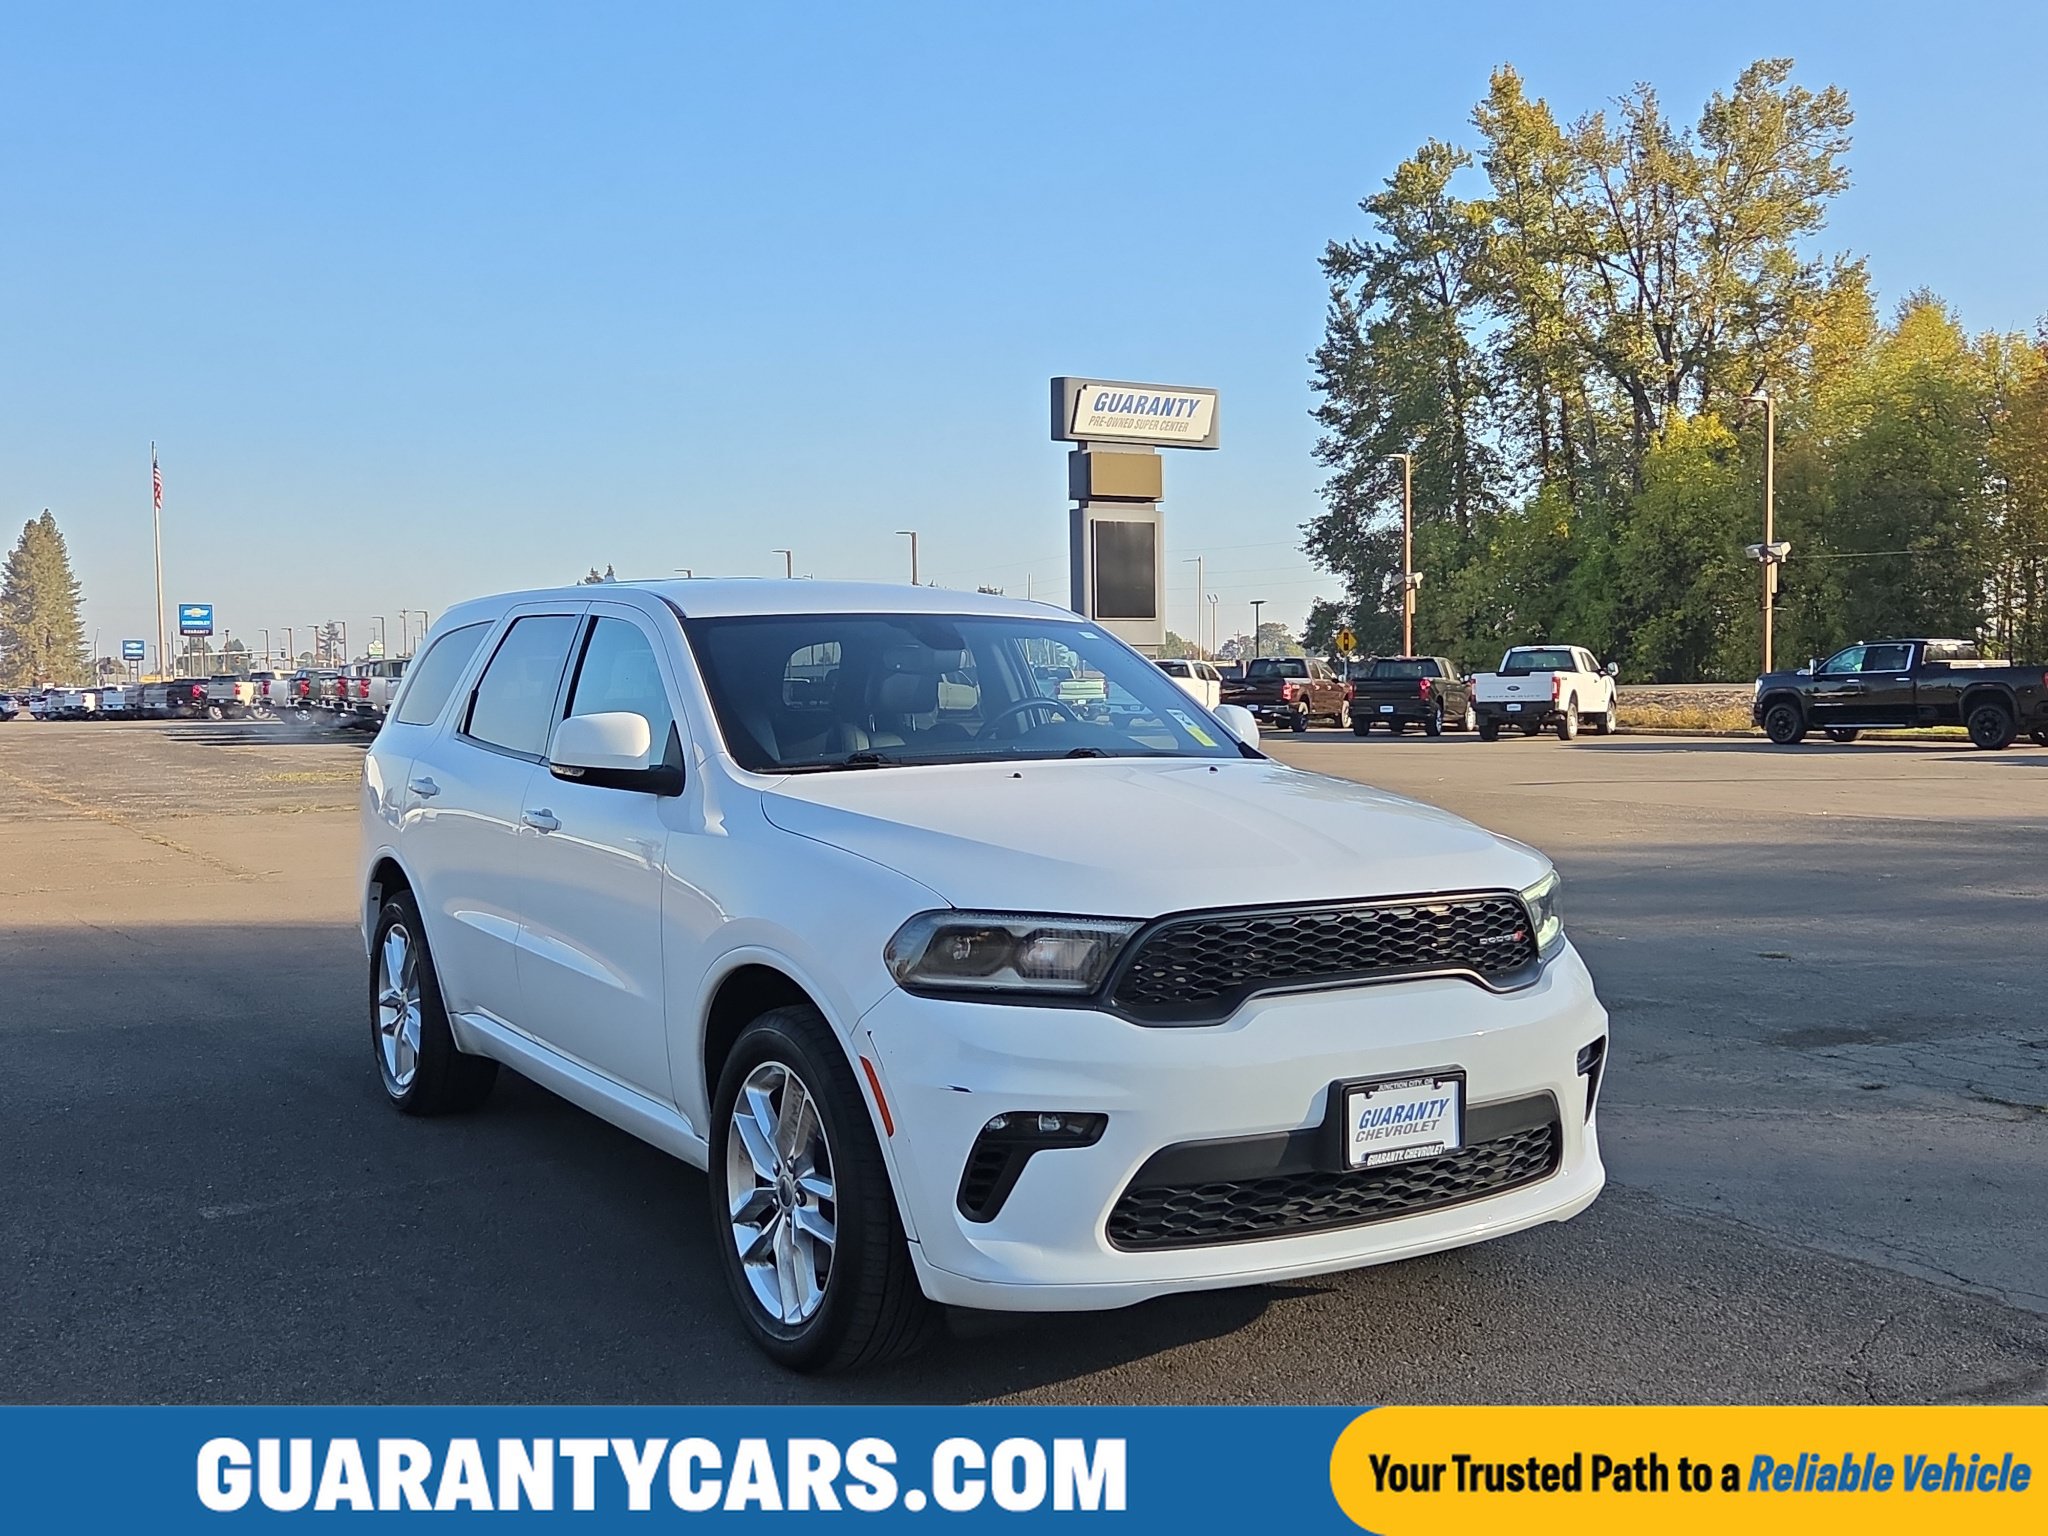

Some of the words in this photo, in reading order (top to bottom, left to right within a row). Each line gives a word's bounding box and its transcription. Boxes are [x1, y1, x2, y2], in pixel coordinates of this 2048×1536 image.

[1093, 392, 1201, 418] GUARANTY
[1088, 415, 1133, 429] PRE-OWNED
[1134, 419, 1160, 430] SUPER
[1160, 420, 1189, 433] CENTER
[1359, 1098, 1450, 1129] GUARANTY
[1355, 1119, 1440, 1143] CHEVROLET
[1404, 1143, 1444, 1160] CHEVROLET
